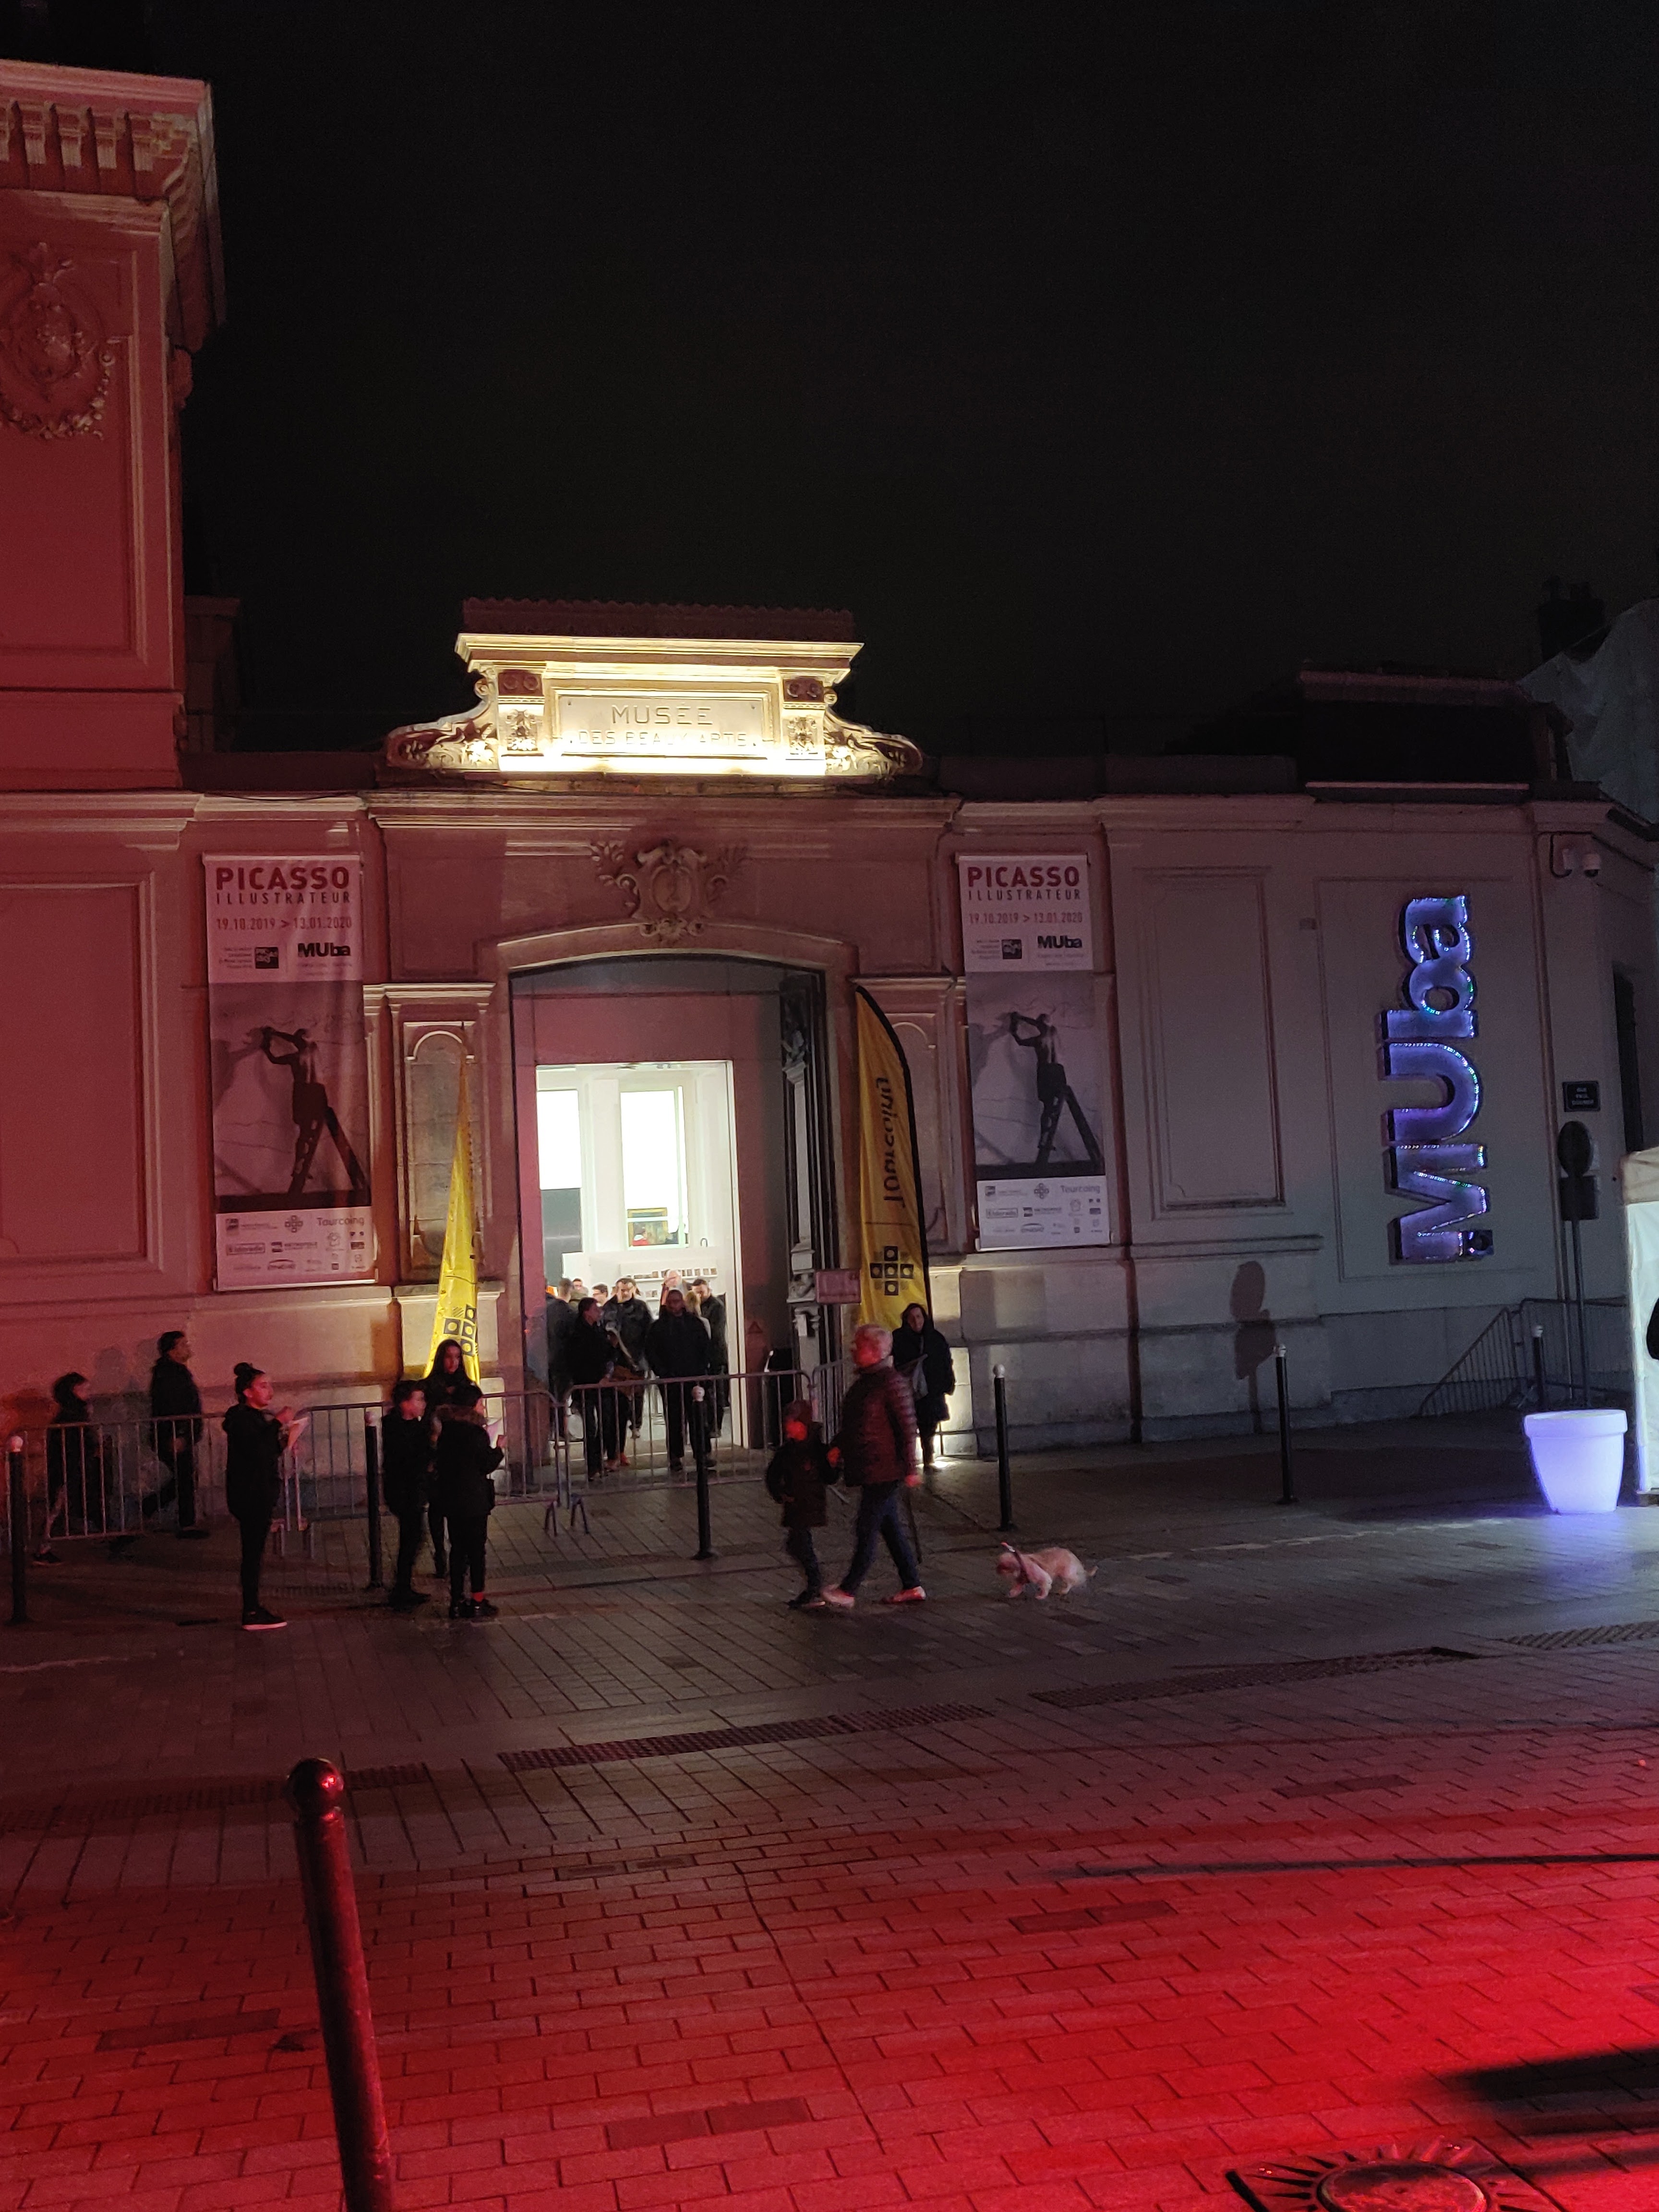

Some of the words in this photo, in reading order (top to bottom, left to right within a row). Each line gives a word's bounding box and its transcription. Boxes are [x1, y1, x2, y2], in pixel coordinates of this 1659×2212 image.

[578, 729, 616, 745] DES
[625, 731, 688, 745] BEA
[216, 866, 350, 890] PICASSO
[967, 866, 1080, 888] PICASSO
[216, 891, 350, 905] ILLUSTRATEUR
[968, 889, 1081, 902] ILLUSTRATEUR
[1037, 935, 1083, 949] MUba
[297, 942, 351, 958] MUba
[316, 1216, 365, 1227] Tourcoing
